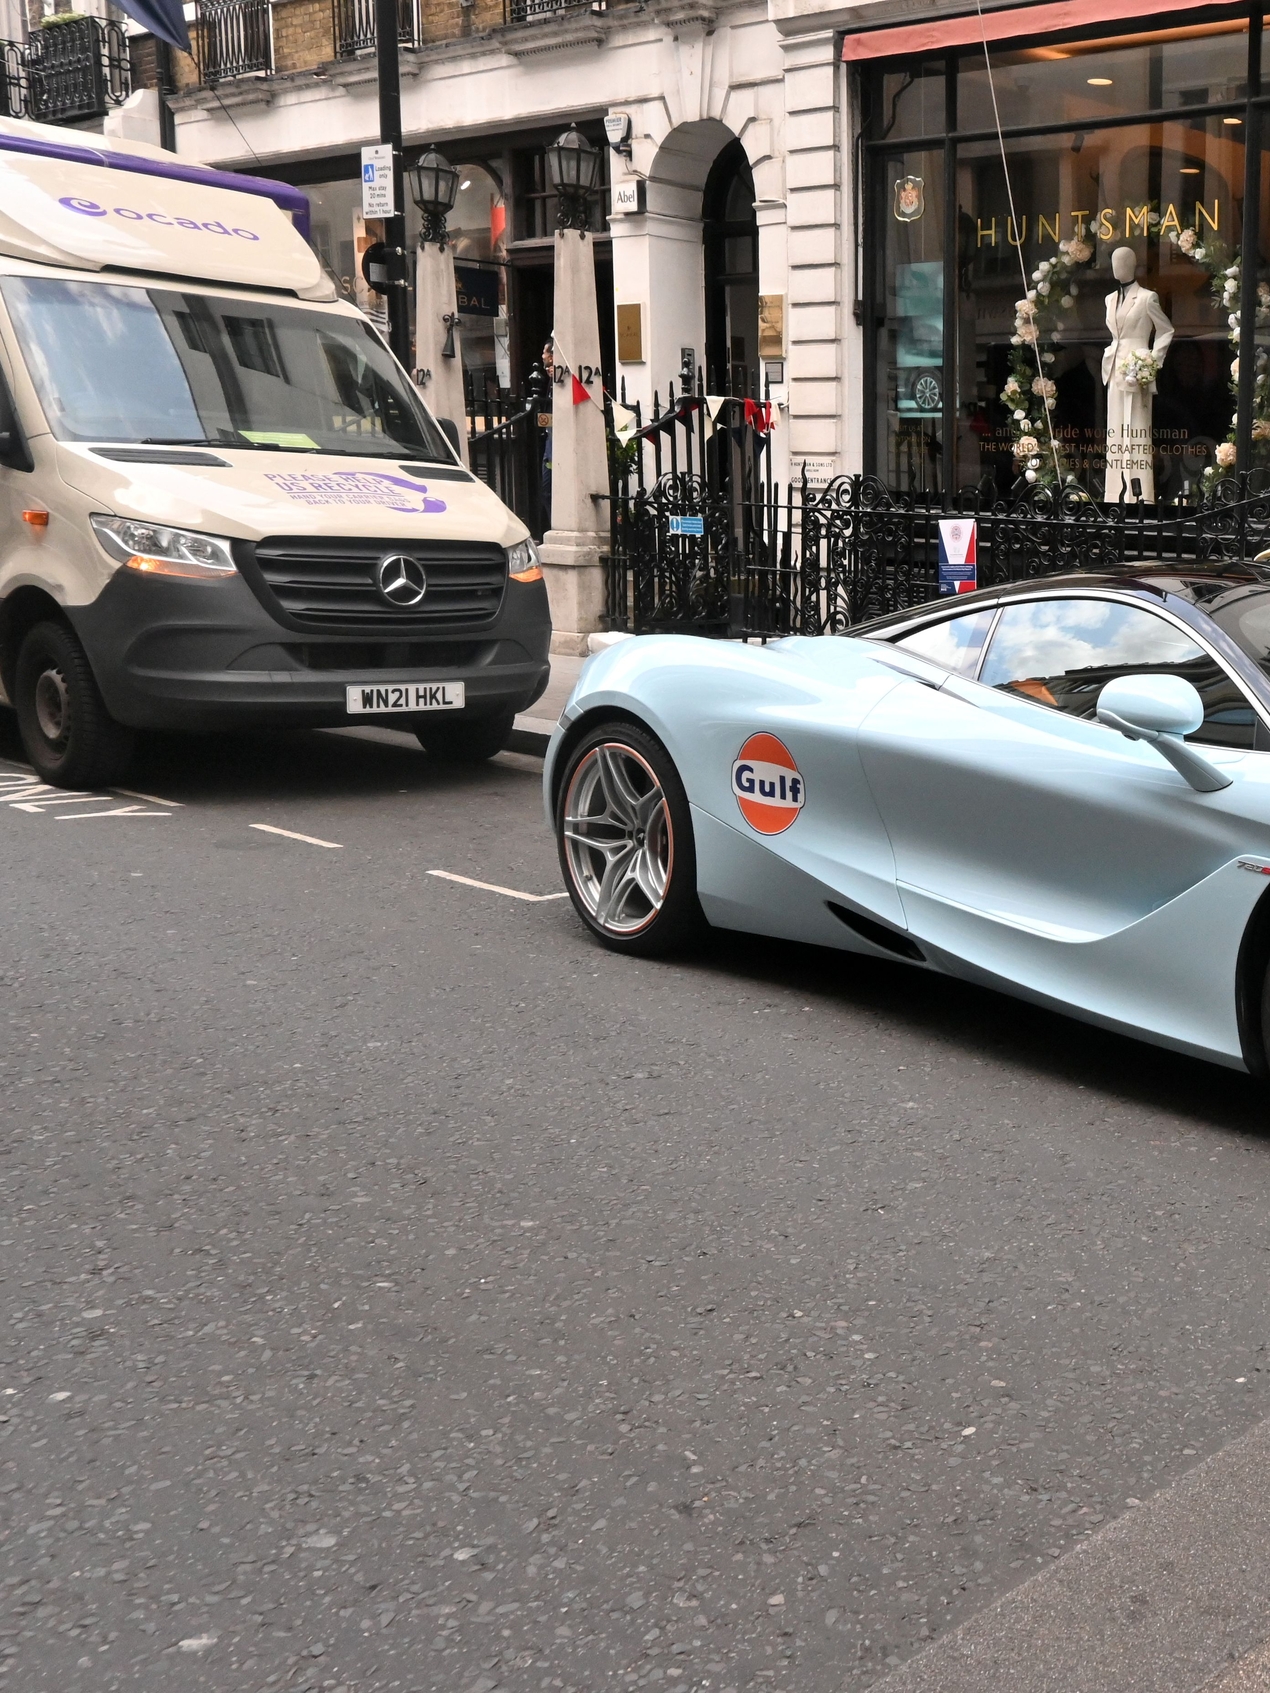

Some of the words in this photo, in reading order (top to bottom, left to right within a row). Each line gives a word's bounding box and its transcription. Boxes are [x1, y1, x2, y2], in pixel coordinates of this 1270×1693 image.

[617, 190, 635, 204] Abel
[113, 207, 260, 241] ocado
[977, 199, 1219, 248] HUNTSMAN
[578, 364, 602, 385] 12A
[1084, 427, 1115, 438] wore
[1121, 424, 1188, 439] Huntsman
[979, 442, 997, 452] THE
[998, 442, 1039, 453] WORLD'
[1080, 443, 1156, 455] HANDCRAFTED
[1160, 445, 1208, 456] CLOTHES
[1082, 458, 1090, 469] &
[1092, 459, 1154, 470] GENTLEMEN
[263, 473, 338, 483] PLEASE
[339, 474, 387, 486] HELP
[275, 482, 307, 492] US
[313, 483, 403, 496] RECYCLE
[361, 687, 409, 709] WN21
[415, 686, 454, 707] HKL
[735, 763, 801, 803] Gulf
